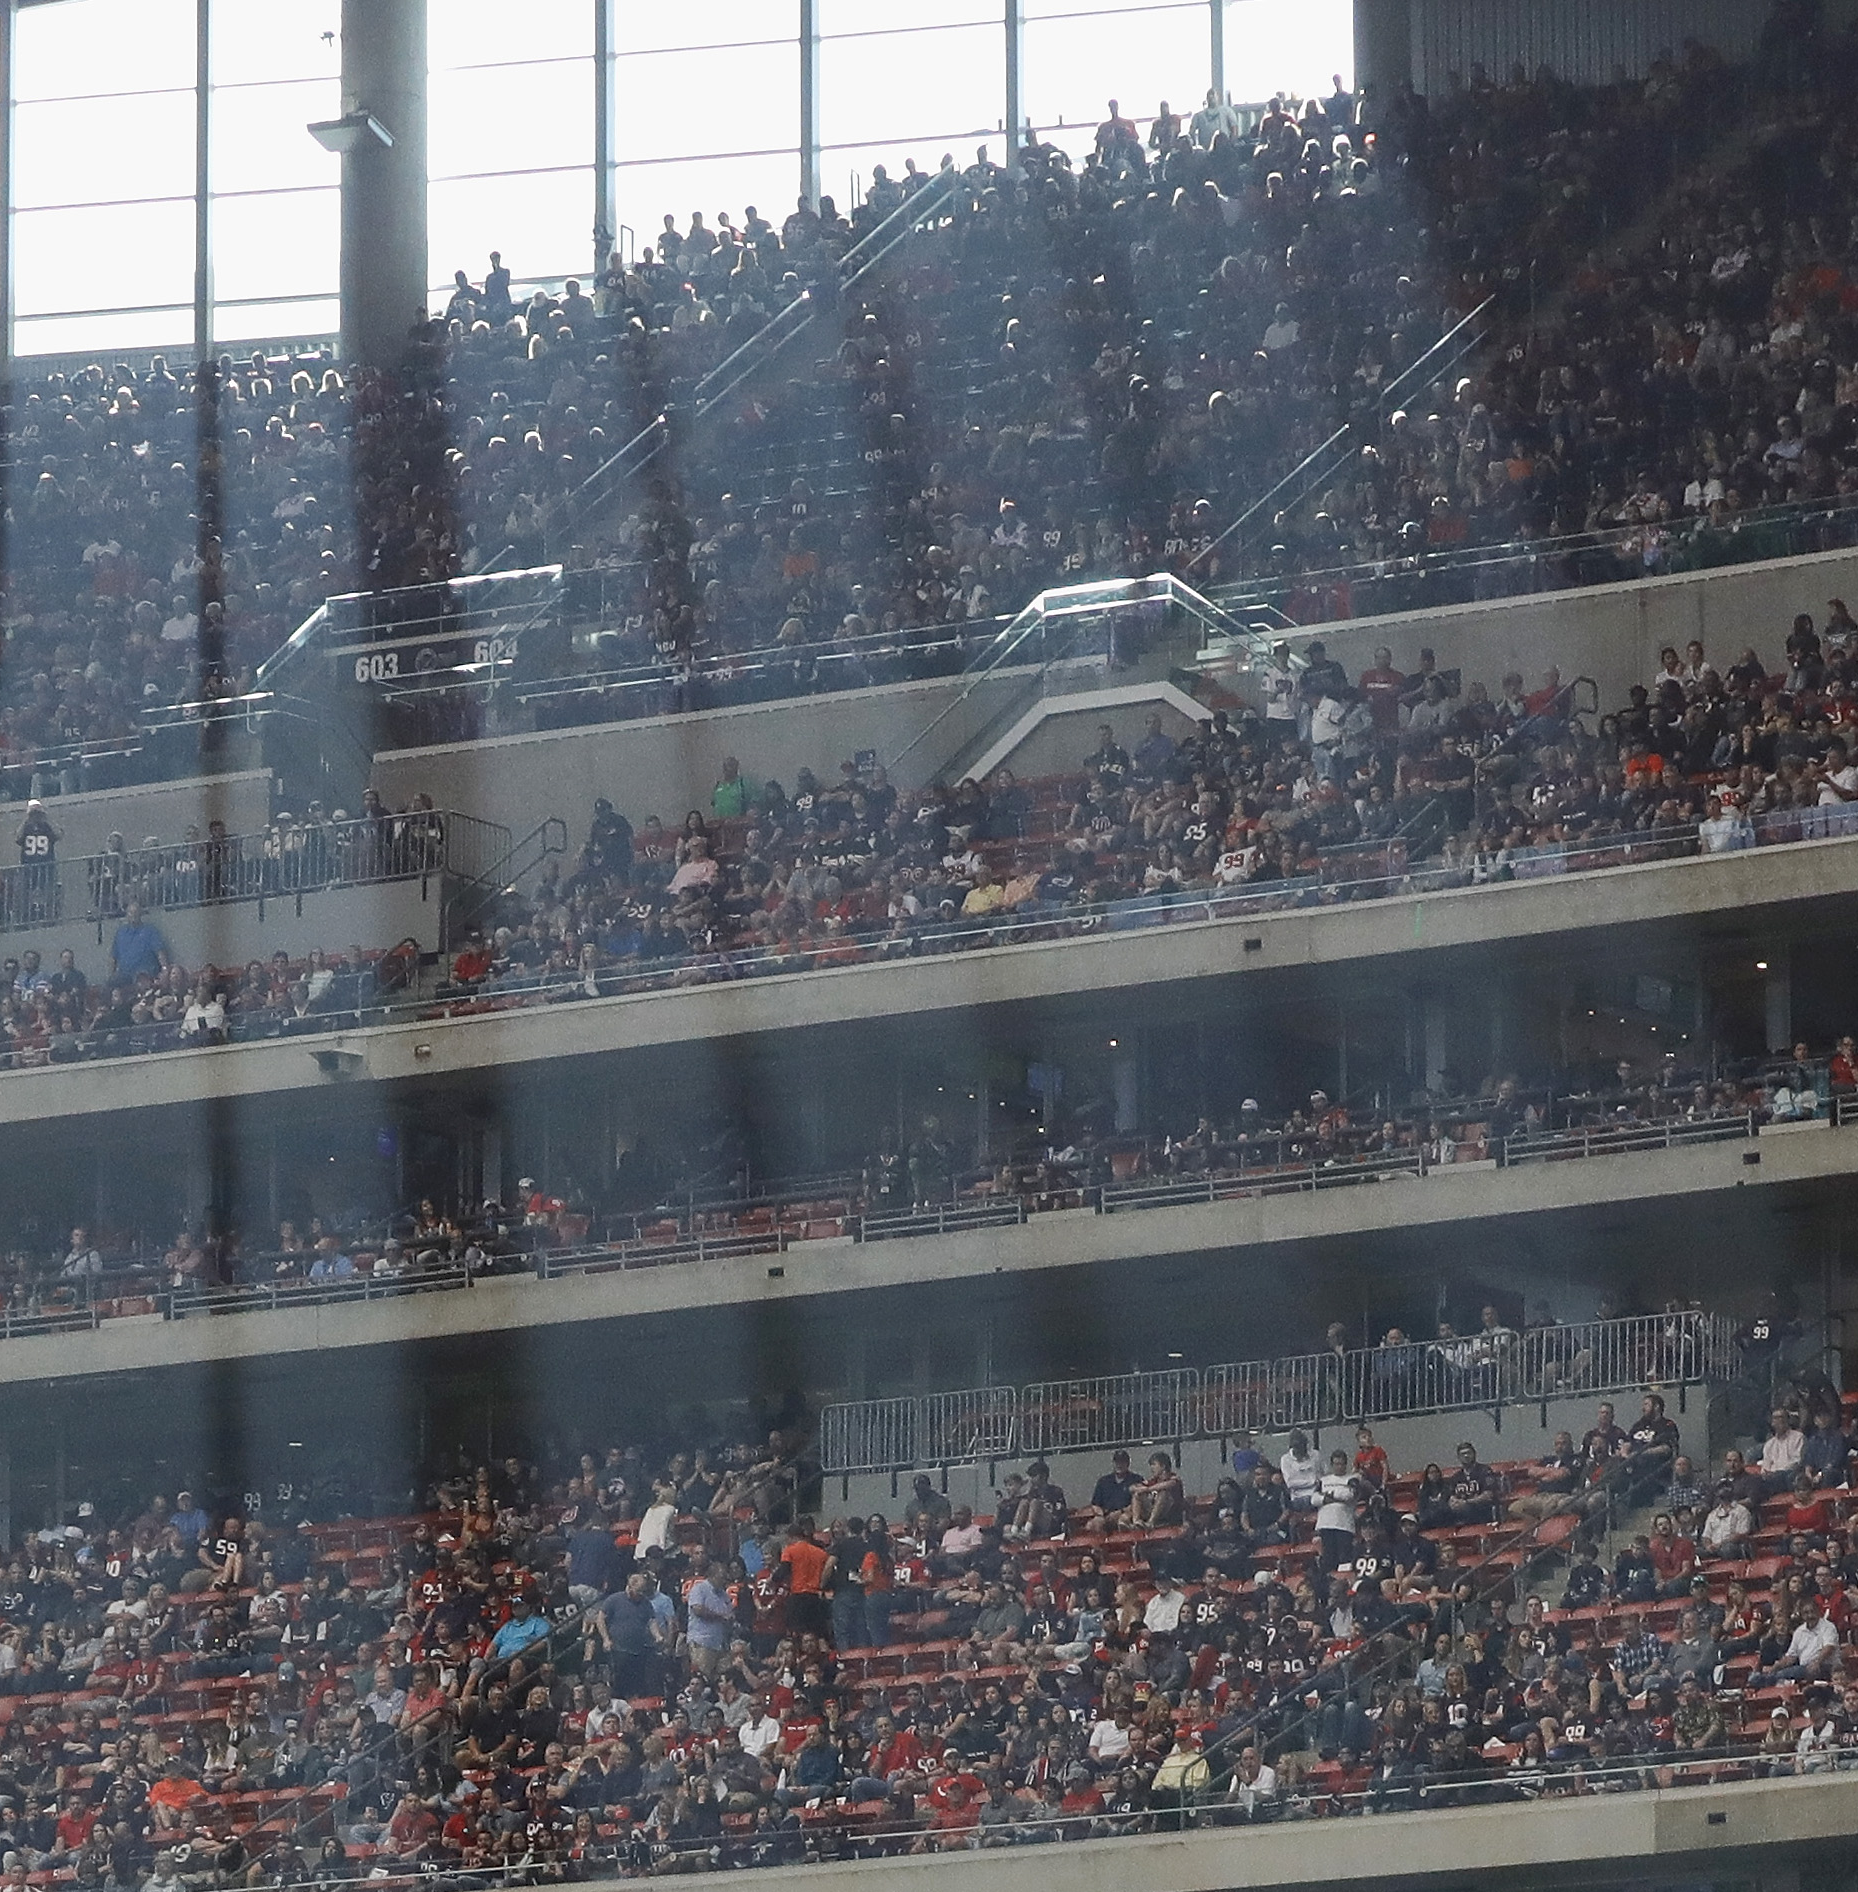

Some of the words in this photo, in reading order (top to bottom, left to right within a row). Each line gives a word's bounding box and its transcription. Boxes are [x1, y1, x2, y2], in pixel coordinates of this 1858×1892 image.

[355, 655, 399, 683] 603
[24, 834, 50, 856] 99
[1752, 1326, 1770, 1339] 99
[215, 1540, 238, 1555] 59
[1355, 1557, 1377, 1576] 99
